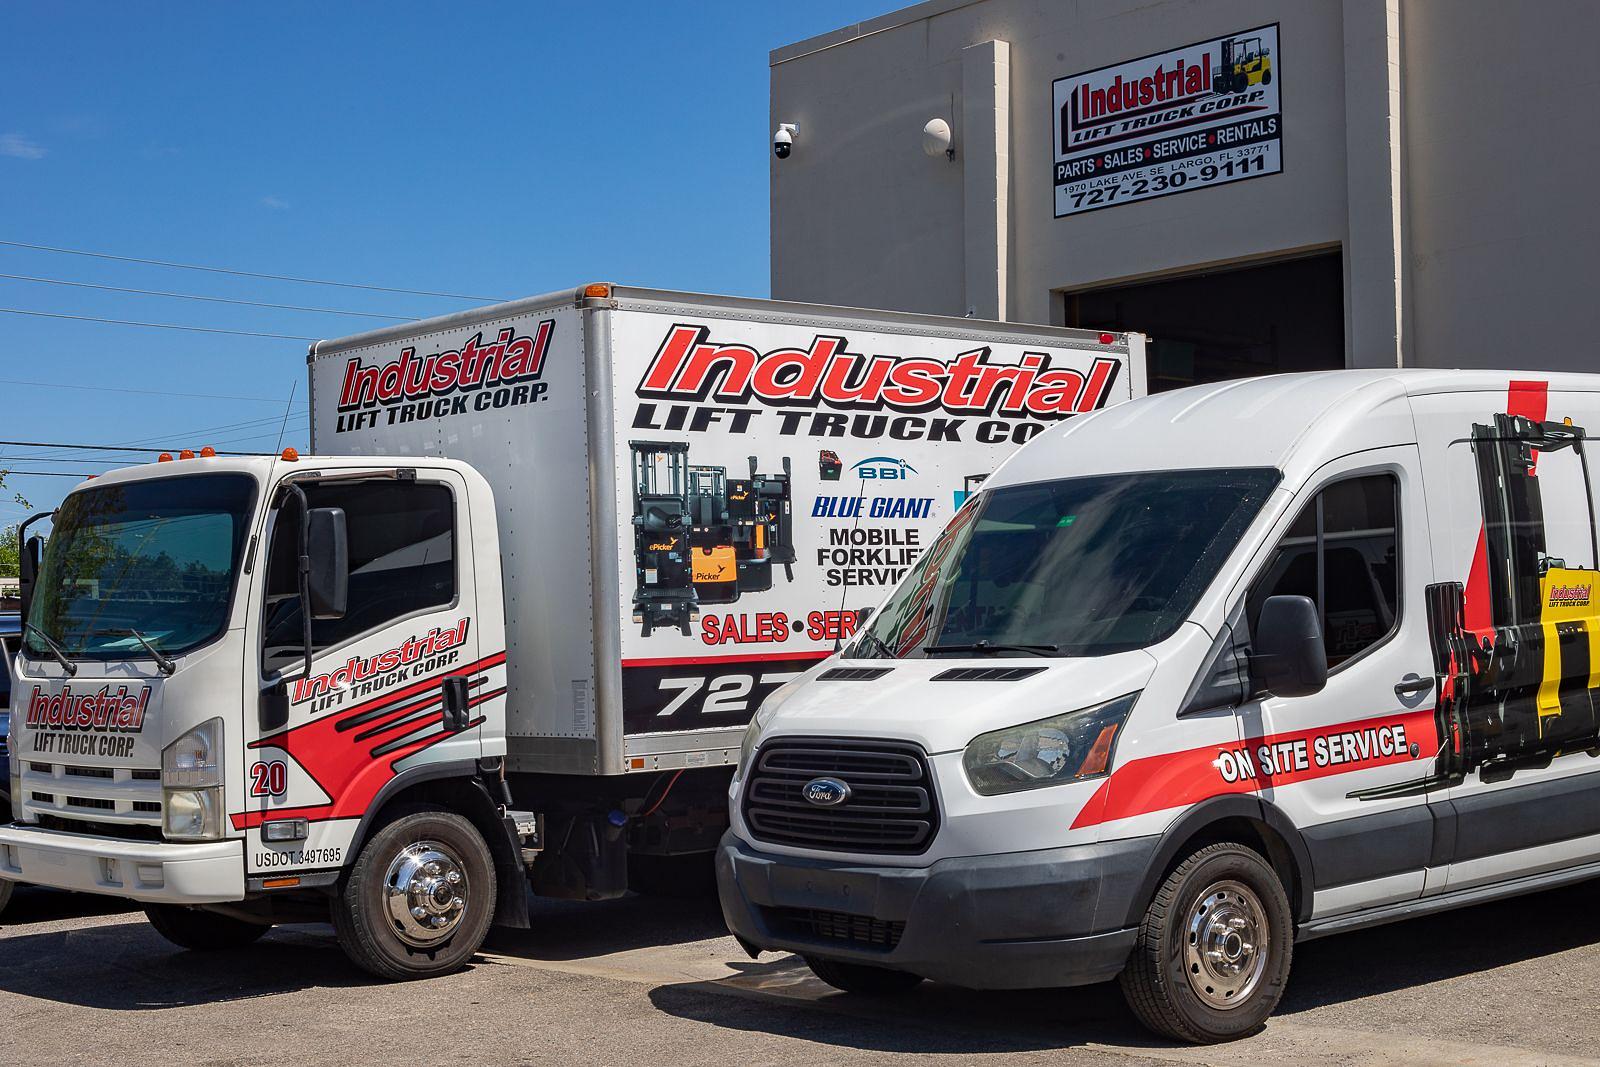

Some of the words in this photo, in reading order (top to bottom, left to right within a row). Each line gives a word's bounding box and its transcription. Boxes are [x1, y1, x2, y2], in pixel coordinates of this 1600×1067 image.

[1082, 52, 1211, 120] Industrial
[1072, 123, 1118, 143] LIFT
[1120, 105, 1194, 132] TRUCK
[1199, 90, 1265, 113] CORP.
[1057, 157, 1095, 180] PARTS
[1104, 147, 1144, 169] SALES
[1153, 133, 1207, 159] SERVICE
[1217, 118, 1277, 145] RENTALS
[1063, 182, 1087, 194] 1970
[1090, 175, 1119, 189] LAKE
[1150, 166, 1164, 176] SE
[1171, 156, 1216, 172] LARGO,
[1219, 151, 1233, 162] FL
[1237, 144, 1270, 158] 33771
[1070, 154, 1266, 209] 727-230-9111
[338, 319, 556, 413] Industrial
[635, 323, 1122, 421] Industrial
[336, 409, 381, 433] LIFT
[386, 394, 470, 425] TRUCK
[473, 382, 549, 411] CORP.
[632, 403, 763, 434] LIFT
[776, 410, 964, 442] TRUCK
[975, 419, 1054, 445] CO
[811, 496, 867, 518] BLUE
[869, 497, 935, 519] GIANT
[817, 548, 924, 566] FORKLIF
[829, 528, 920, 546] MOBILE
[701, 612, 789, 646] SALES
[807, 610, 860, 641] SER
[290, 616, 471, 707] Industrial
[310, 690, 347, 714] LIFT
[350, 667, 410, 699] TRUCK
[412, 650, 459, 676] CORP.
[26, 684, 152, 733] Industrial
[33, 732, 57, 753] LIFT
[57, 733, 98, 756] TRUCK
[98, 735, 135, 758] CORP.
[1218, 746, 1256, 784] ON
[1257, 738, 1309, 776] SITE
[1313, 724, 1408, 767] SERVICE
[250, 760, 288, 798] 20
[809, 784, 833, 800] Ford
[255, 850, 296, 868] USDOT
[298, 847, 341, 864] 3497695
